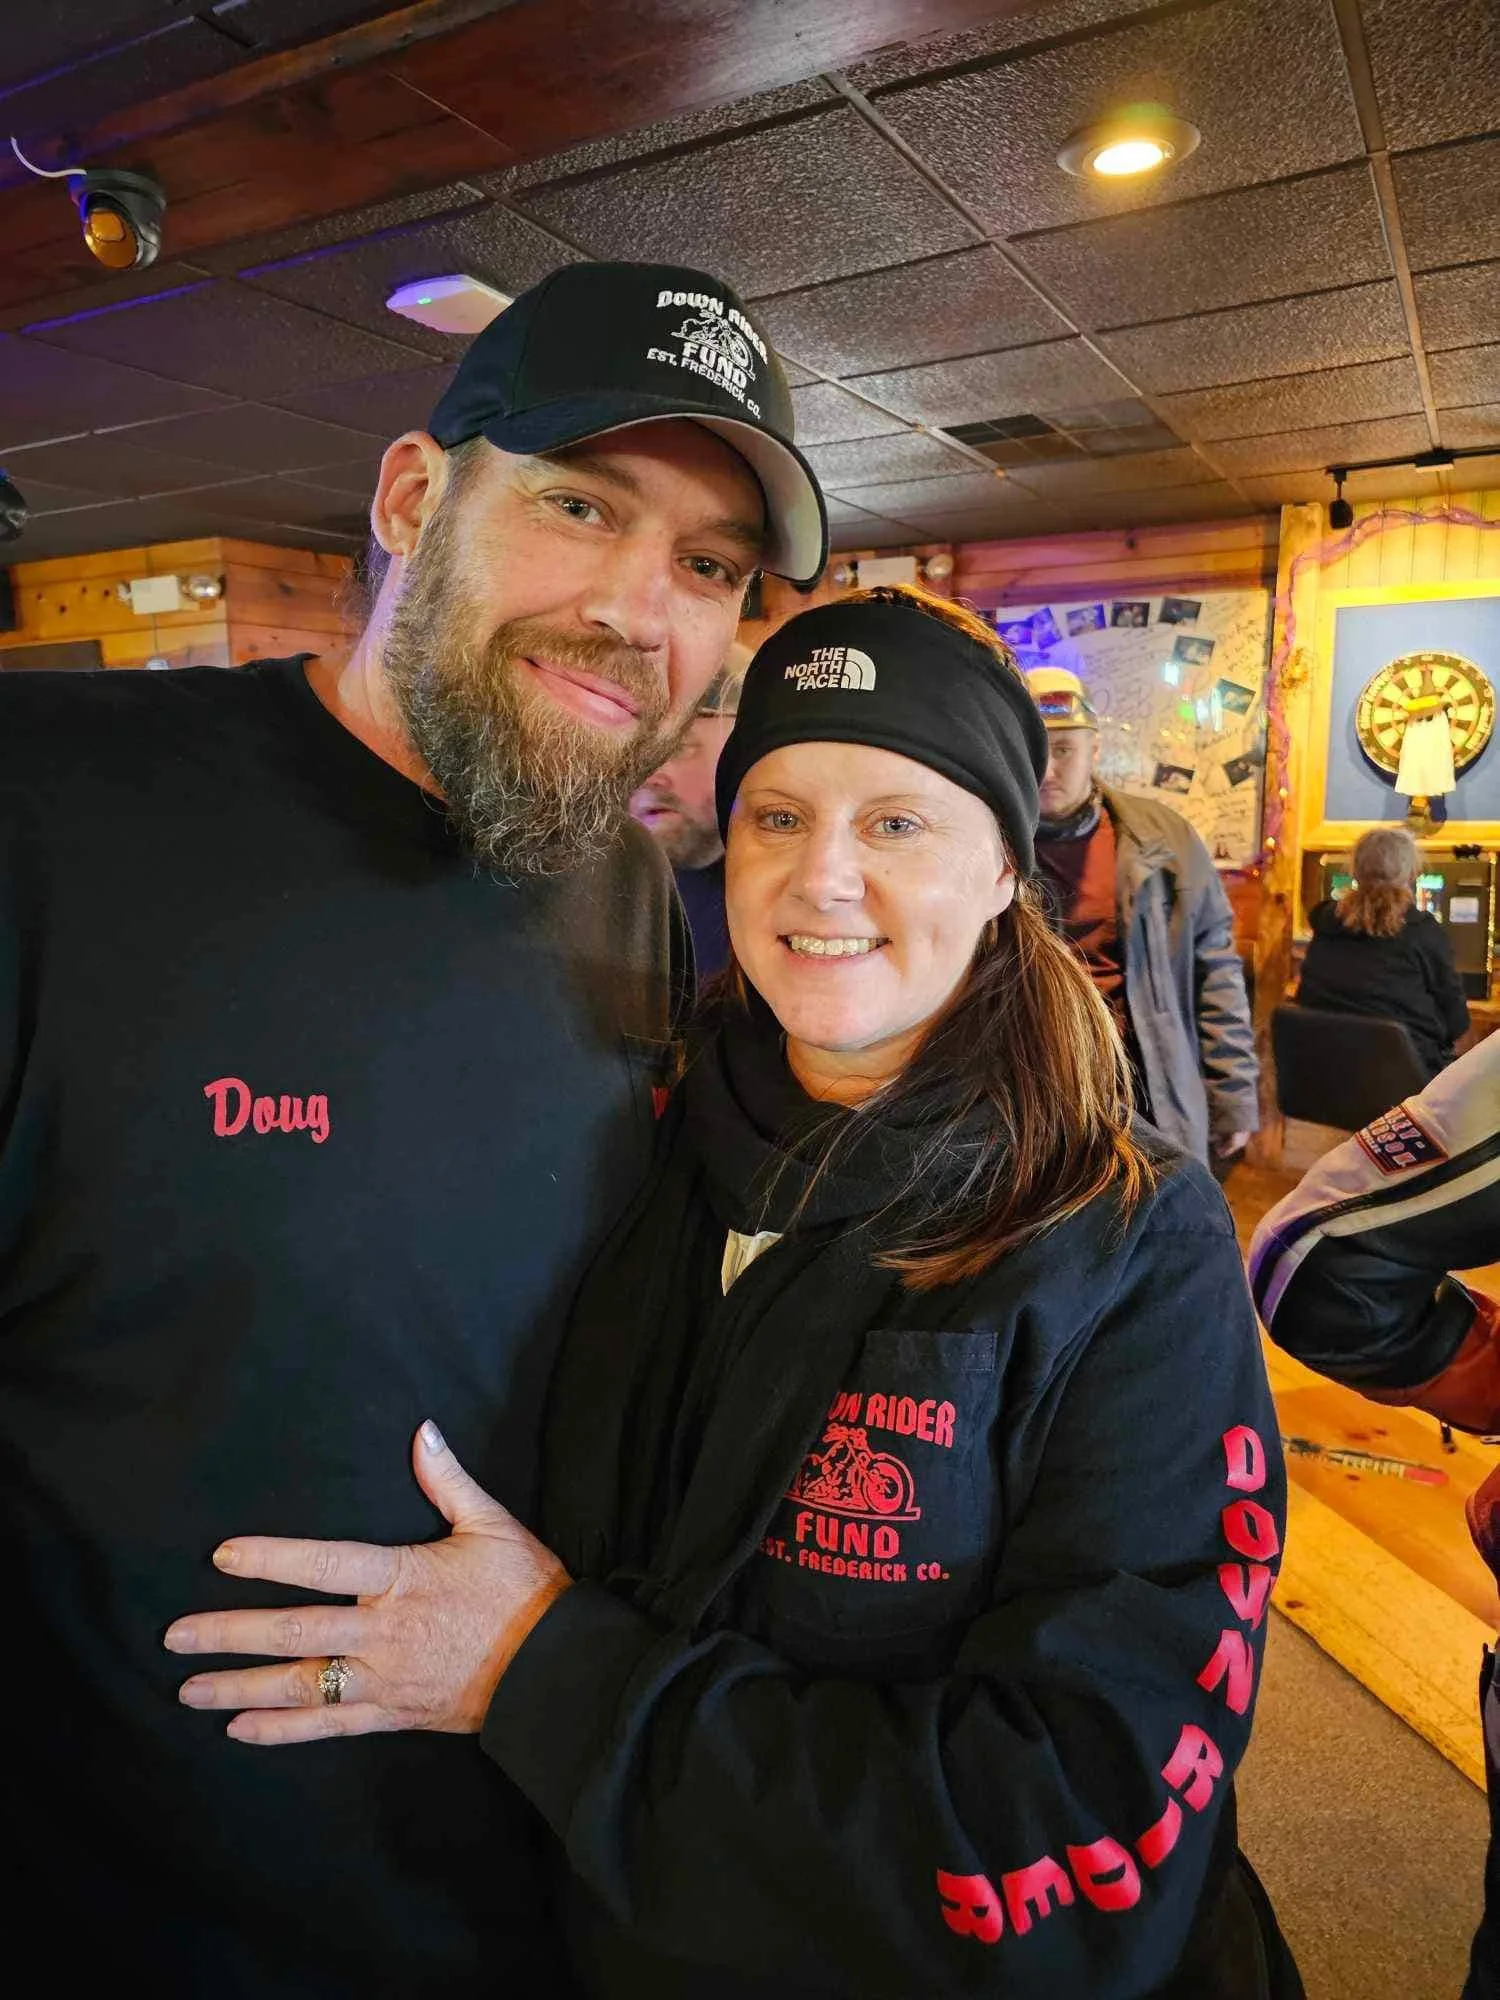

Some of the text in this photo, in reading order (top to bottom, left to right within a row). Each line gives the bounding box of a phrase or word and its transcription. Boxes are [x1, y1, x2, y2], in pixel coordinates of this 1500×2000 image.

[656, 290, 768, 368] DOWN RIDER
[646, 348, 678, 366] EST.
[681, 357, 746, 403] FREDERICK
[682, 341, 748, 390] FUND
[784, 660, 843, 680] NORTH
[811, 647, 846, 662] THE
[796, 674, 841, 691] FACE
[203, 1077, 330, 1144] Doug
[865, 1392, 957, 1449] RIDER
[795, 1510, 901, 1559] FUND
[798, 1549, 907, 1582] FREDERICK
[916, 1561, 950, 1582] CO.
[936, 1425, 1280, 1945] DOWN RIDER
